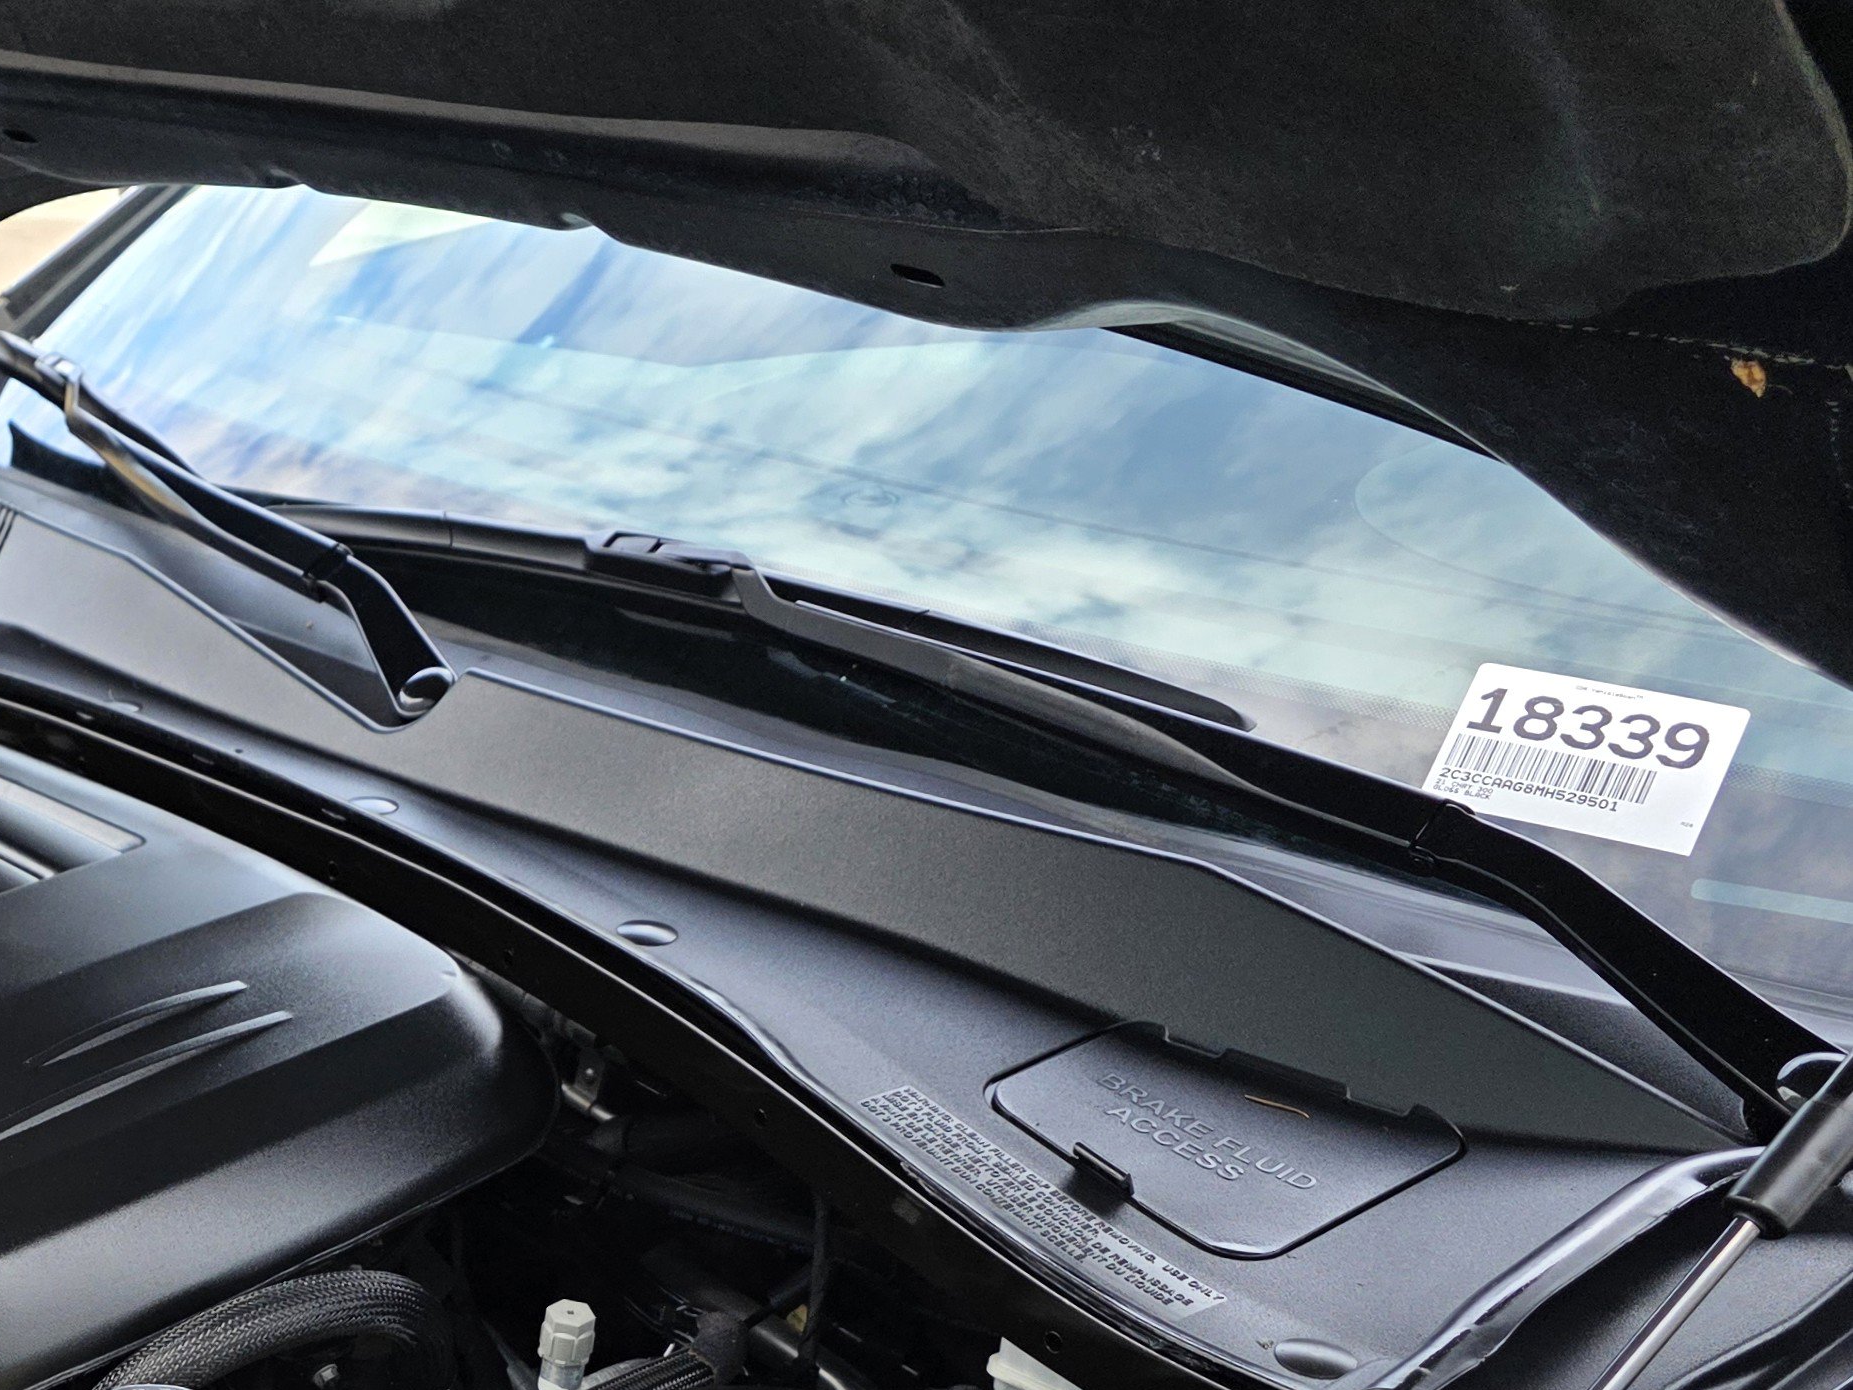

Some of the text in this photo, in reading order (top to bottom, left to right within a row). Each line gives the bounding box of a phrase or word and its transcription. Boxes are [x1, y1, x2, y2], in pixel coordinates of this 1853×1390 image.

[1466, 687, 1710, 769] 18339
[1096, 1072, 1320, 1191] BRAKE FLUID
[1104, 1104, 1247, 1182] ACCESS
